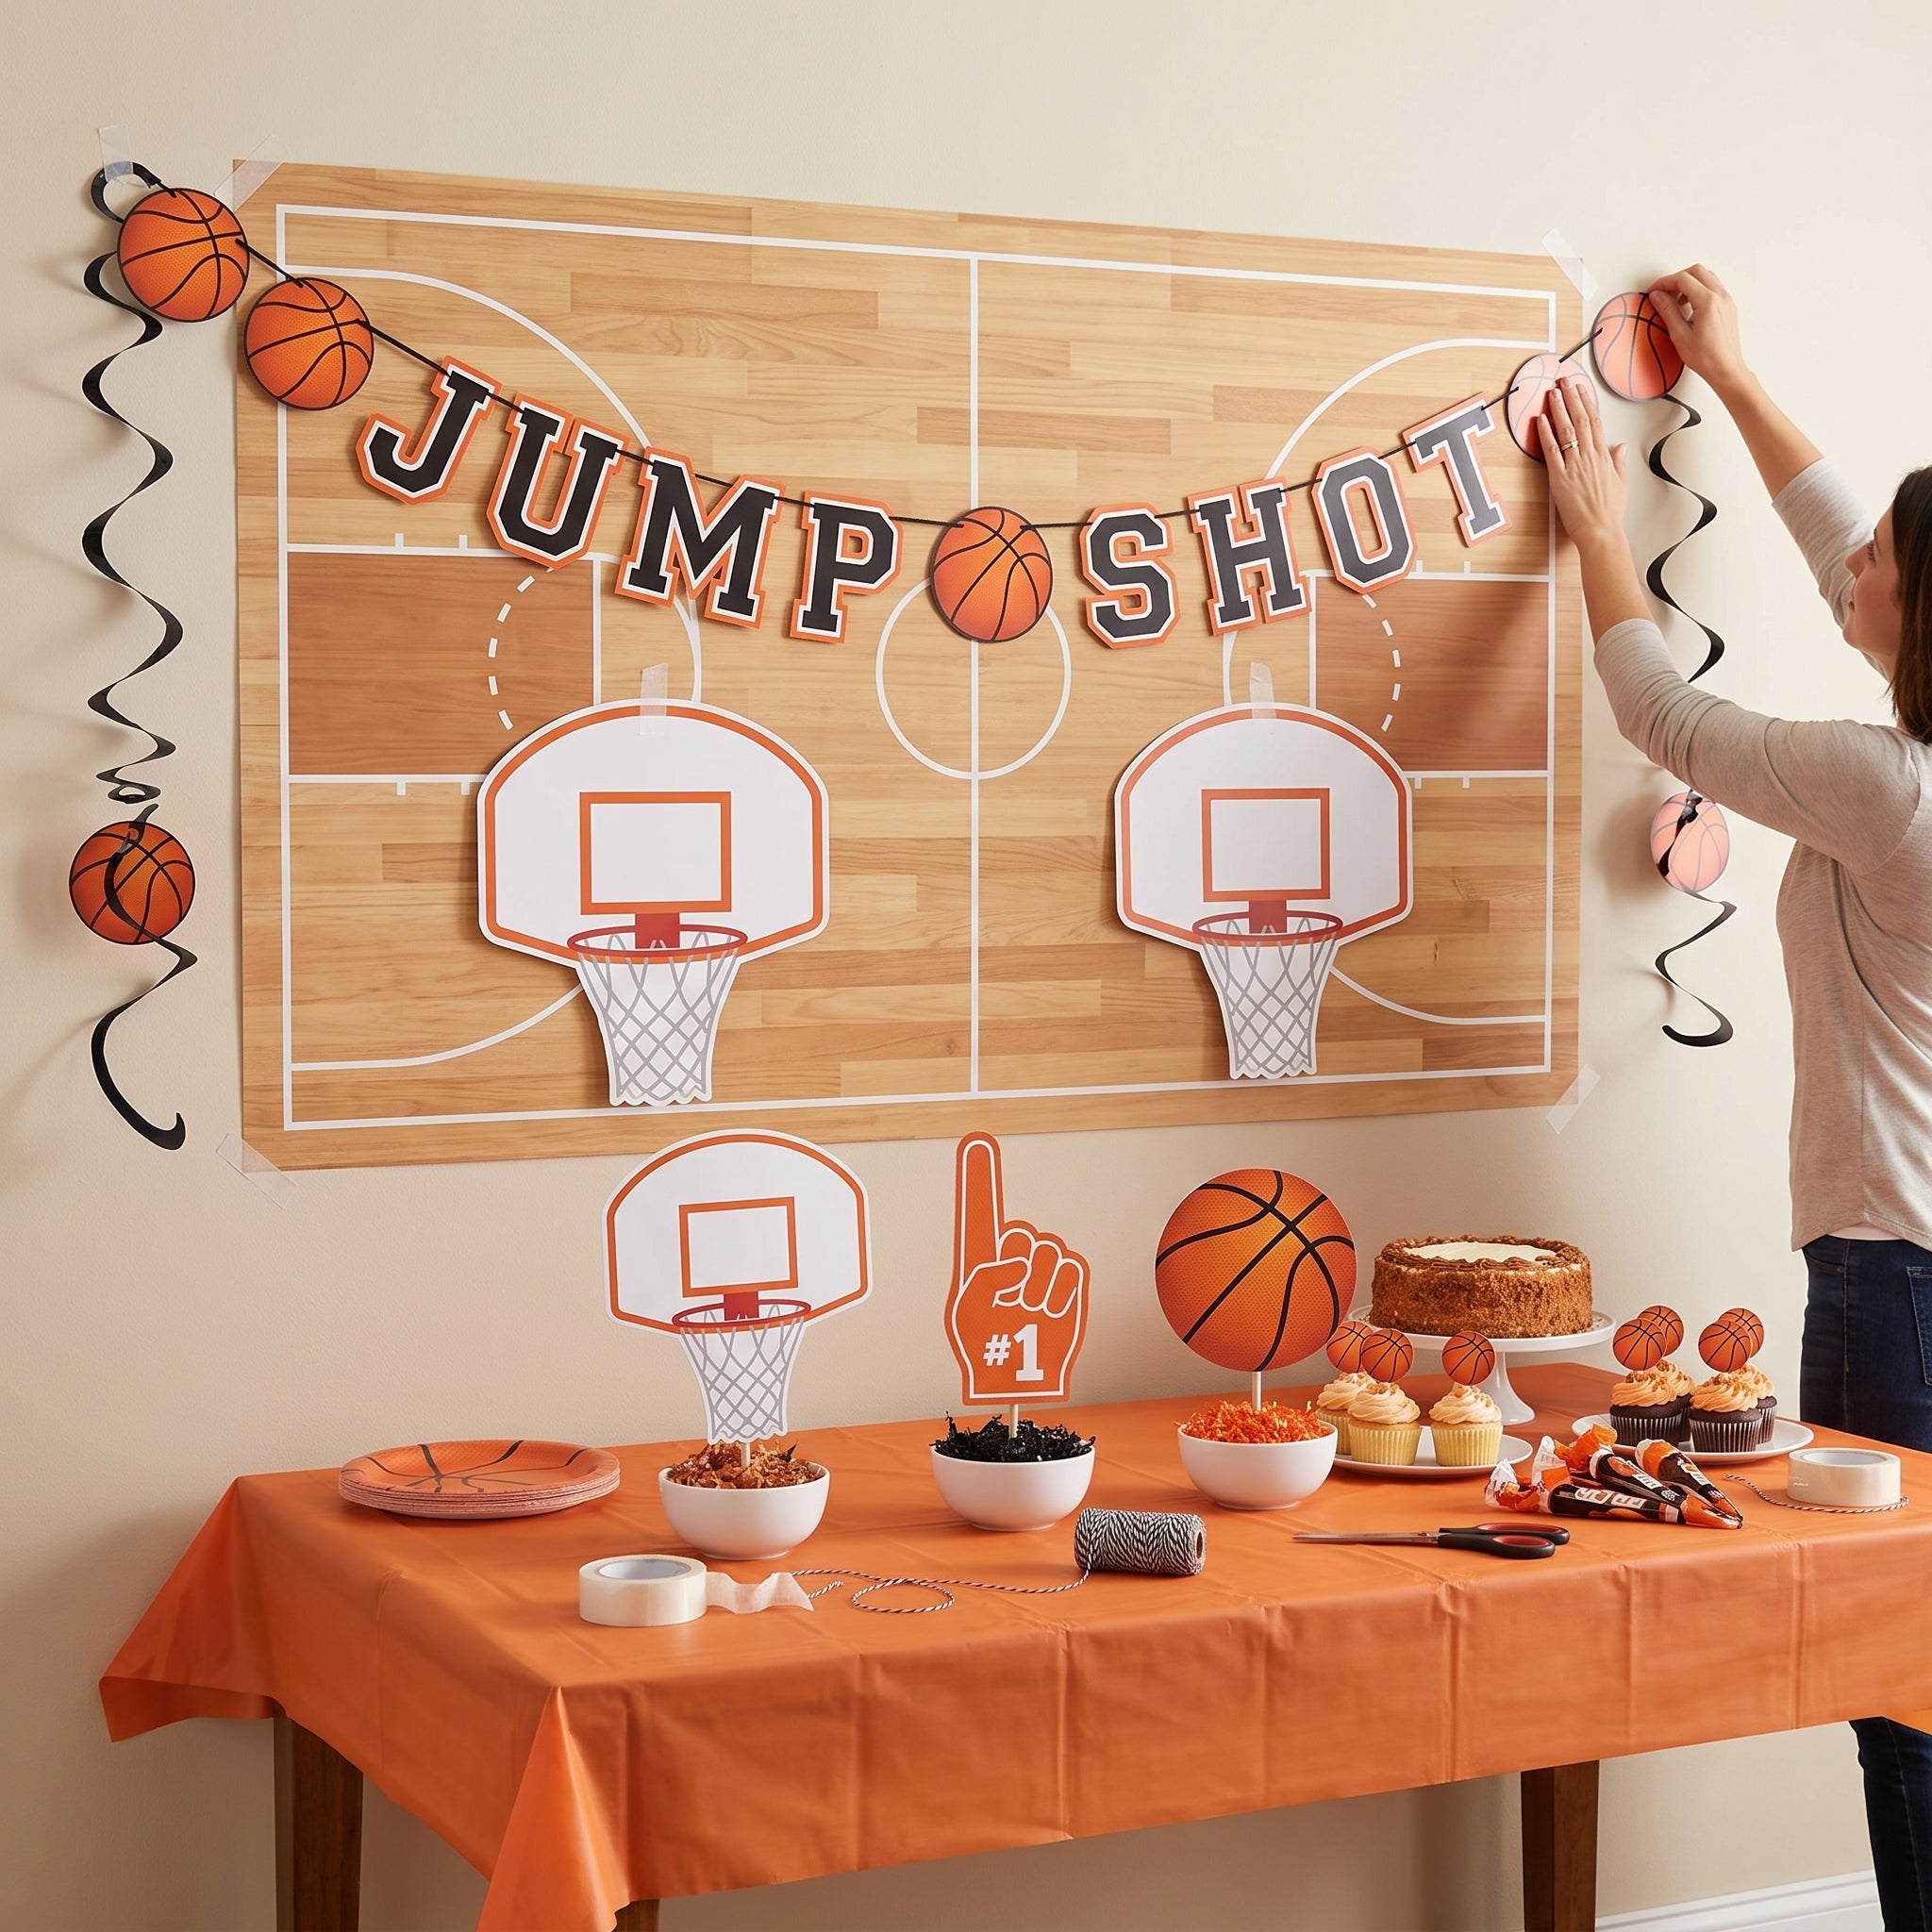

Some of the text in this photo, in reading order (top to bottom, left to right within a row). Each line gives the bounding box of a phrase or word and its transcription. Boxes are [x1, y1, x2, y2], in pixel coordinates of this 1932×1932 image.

[361, 360, 1508, 645] JUMP SHOT
[983, 1324, 1044, 1382] #1
